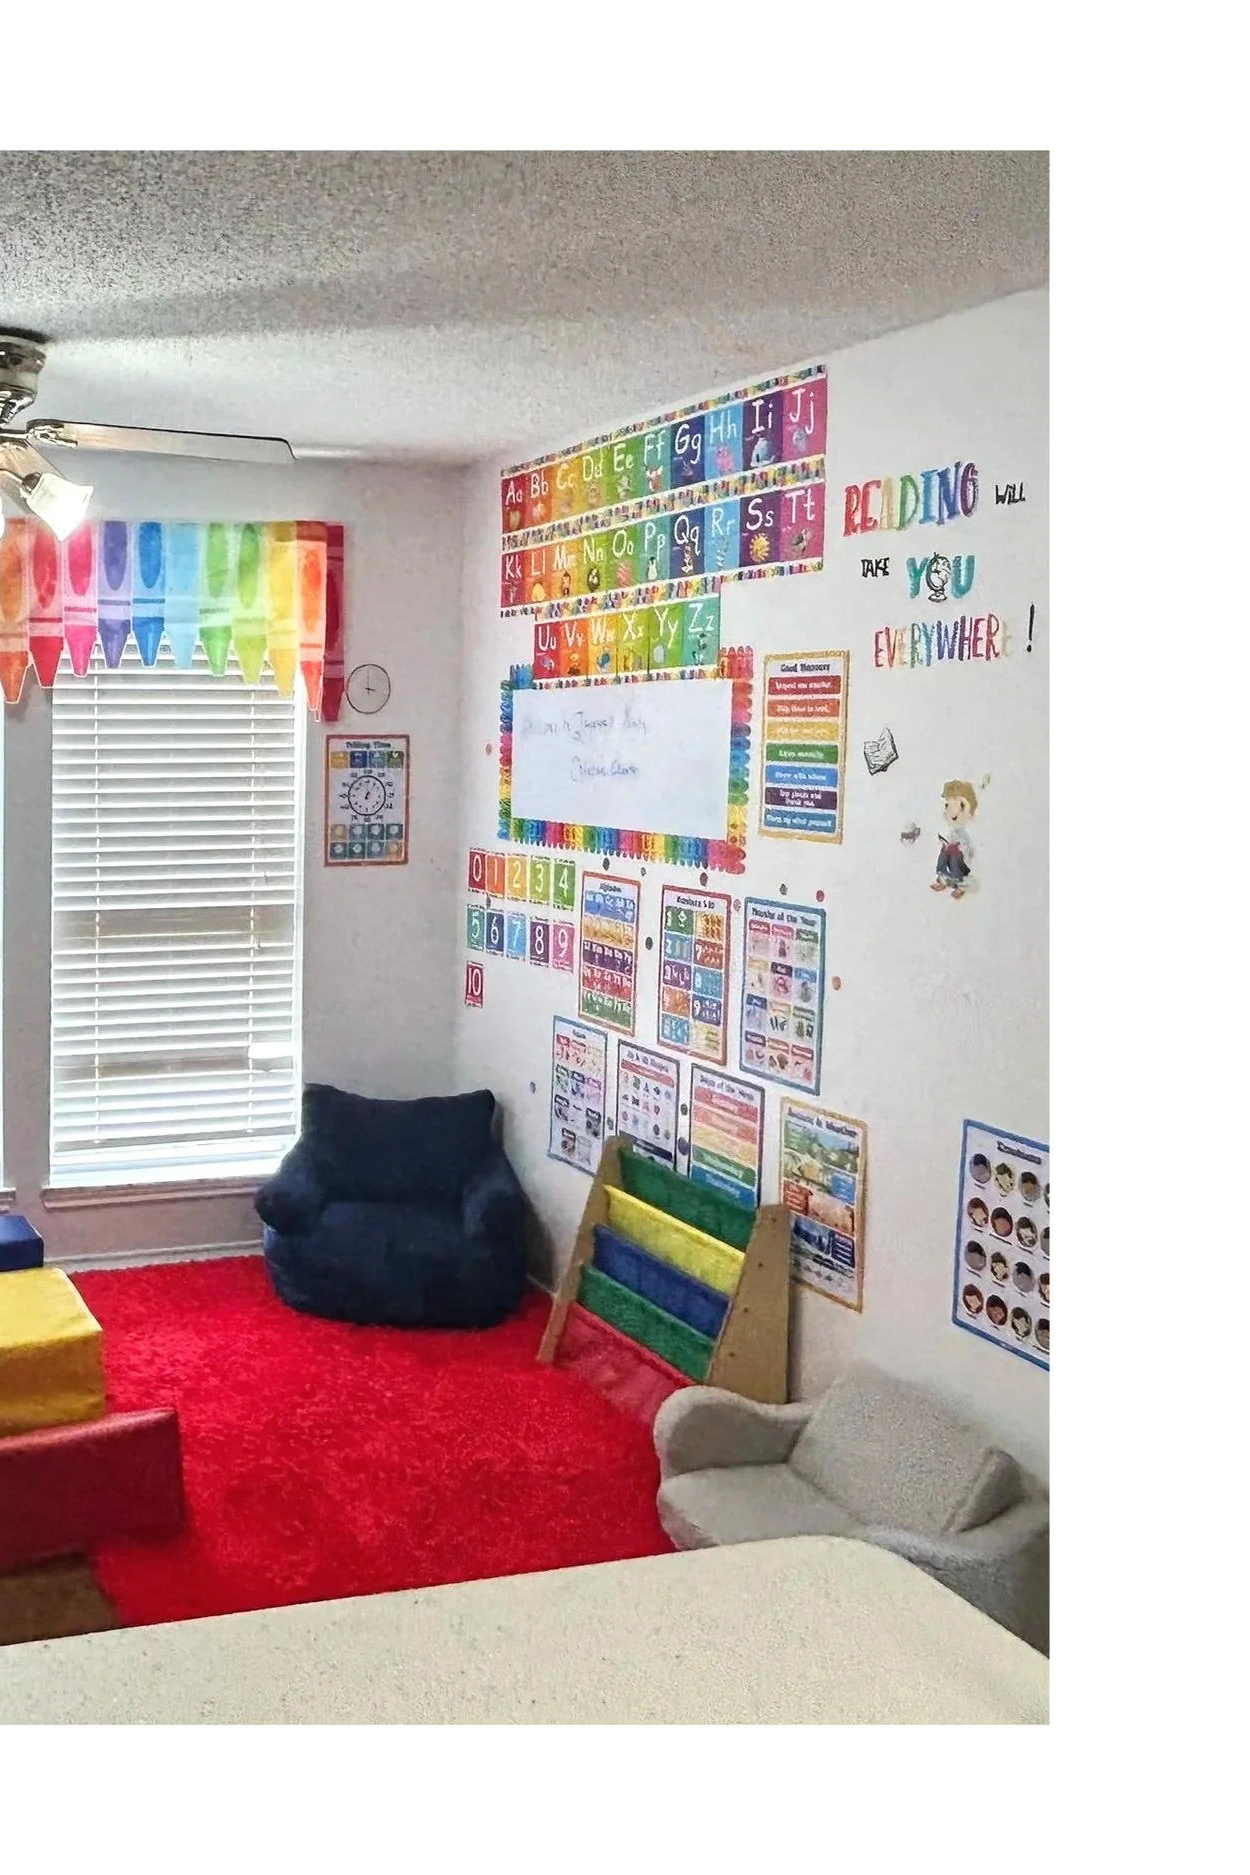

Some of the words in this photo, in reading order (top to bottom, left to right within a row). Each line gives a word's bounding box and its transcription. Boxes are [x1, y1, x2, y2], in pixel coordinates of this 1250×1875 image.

[505, 479, 524, 506] Aa
[530, 470, 550, 498] Bb
[556, 463, 576, 490] Cc
[582, 446, 604, 482] Dd
[613, 443, 634, 472] Ee
[644, 429, 668, 464] Ff
[675, 423, 702, 464] Gg
[709, 410, 738, 444] Hh
[751, 399, 774, 434] Ii
[789, 388, 816, 434] Jj
[843, 461, 980, 538] READING
[995, 481, 1026, 506] WILL
[505, 555, 522, 580] Kk
[530, 550, 546, 576] Ll
[583, 536, 606, 564] Nn
[612, 529, 634, 558] Oo
[644, 521, 666, 562] Pp
[674, 515, 702, 556] Qq
[711, 507, 736, 538] Rr
[745, 498, 774, 530] Ss
[785, 488, 816, 524] Tt
[861, 557, 890, 578] TAKE
[538, 625, 556, 652] Uu
[564, 621, 584, 648] Vv
[621, 610, 644, 642] Xx
[654, 607, 678, 650] Yy
[688, 602, 714, 632] Zz
[473, 854, 482, 882] 0
[494, 858, 498, 886] 1
[512, 860, 522, 888] 2
[535, 863, 544, 894] 3
[558, 867, 568, 898] 4
[471, 911, 480, 940] 5
[490, 916, 500, 946] 6
[512, 920, 522, 948] 7
[535, 925, 544, 956] 8
[558, 929, 568, 958] 9
[468, 967, 482, 996] 10
